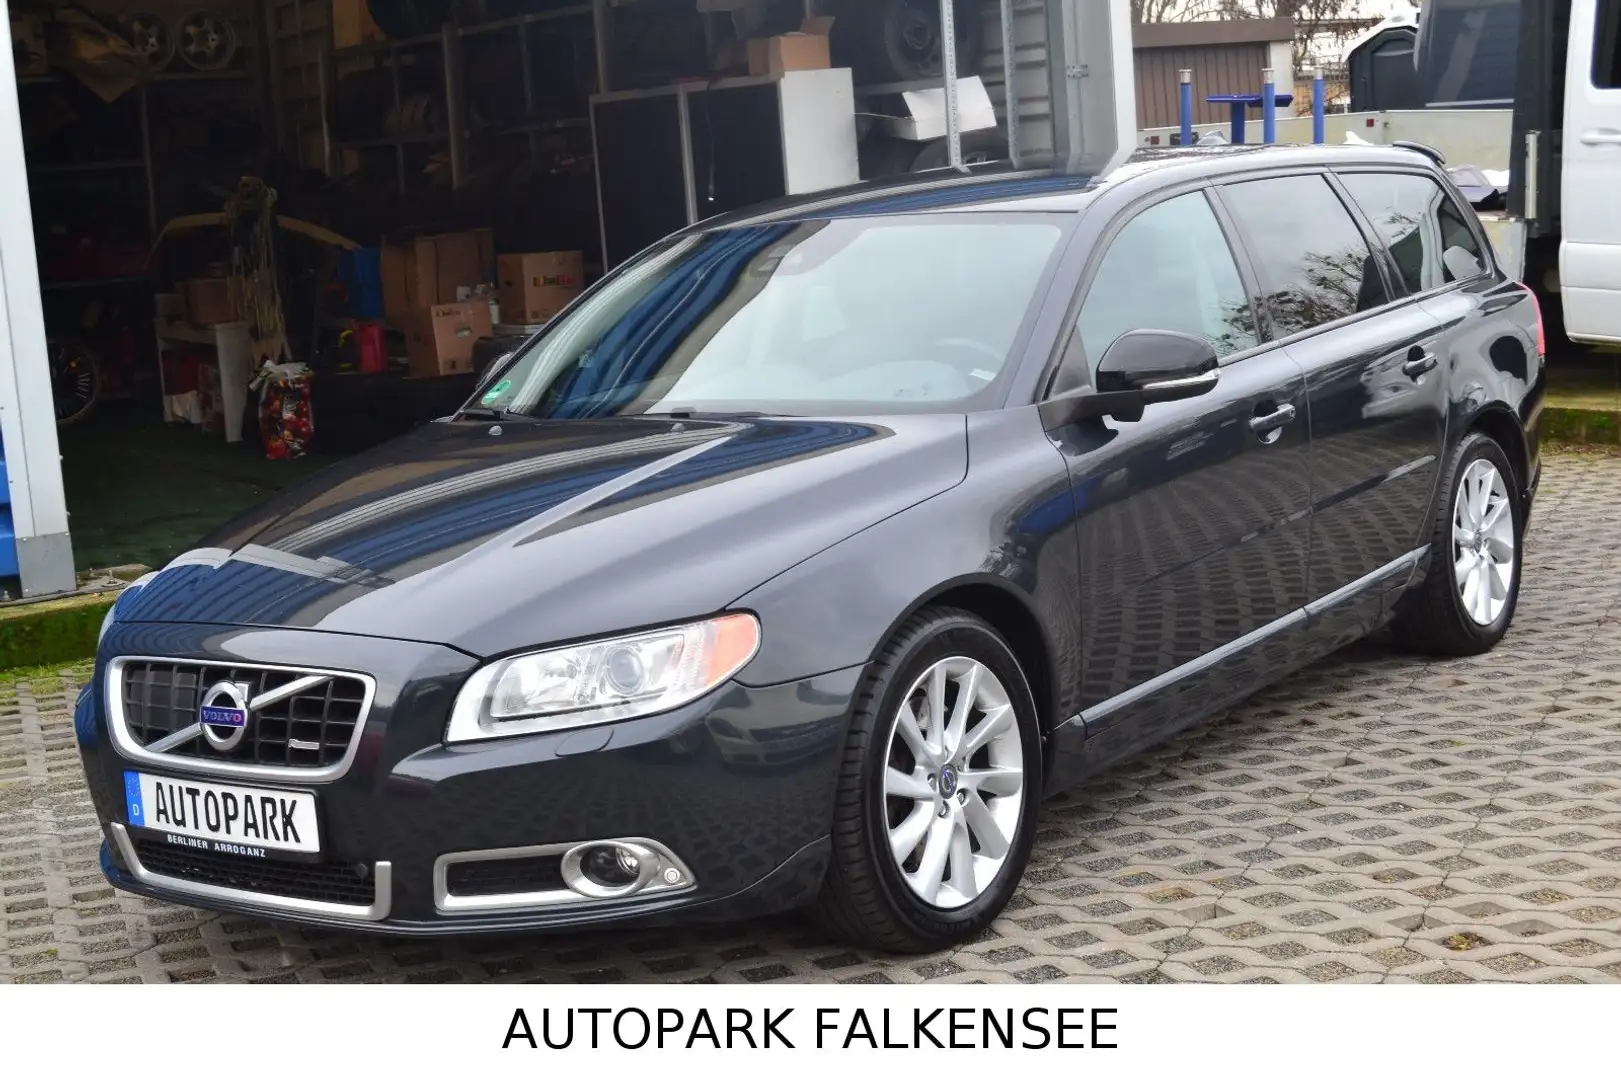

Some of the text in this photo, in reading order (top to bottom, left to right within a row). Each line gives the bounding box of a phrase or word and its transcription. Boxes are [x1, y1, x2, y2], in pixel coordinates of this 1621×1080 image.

[203, 709, 242, 723] VOLVO
[132, 804, 140, 816] D
[156, 781, 301, 843] AUTOPARK
[167, 834, 266, 857] BERLINER ARROGANZ
